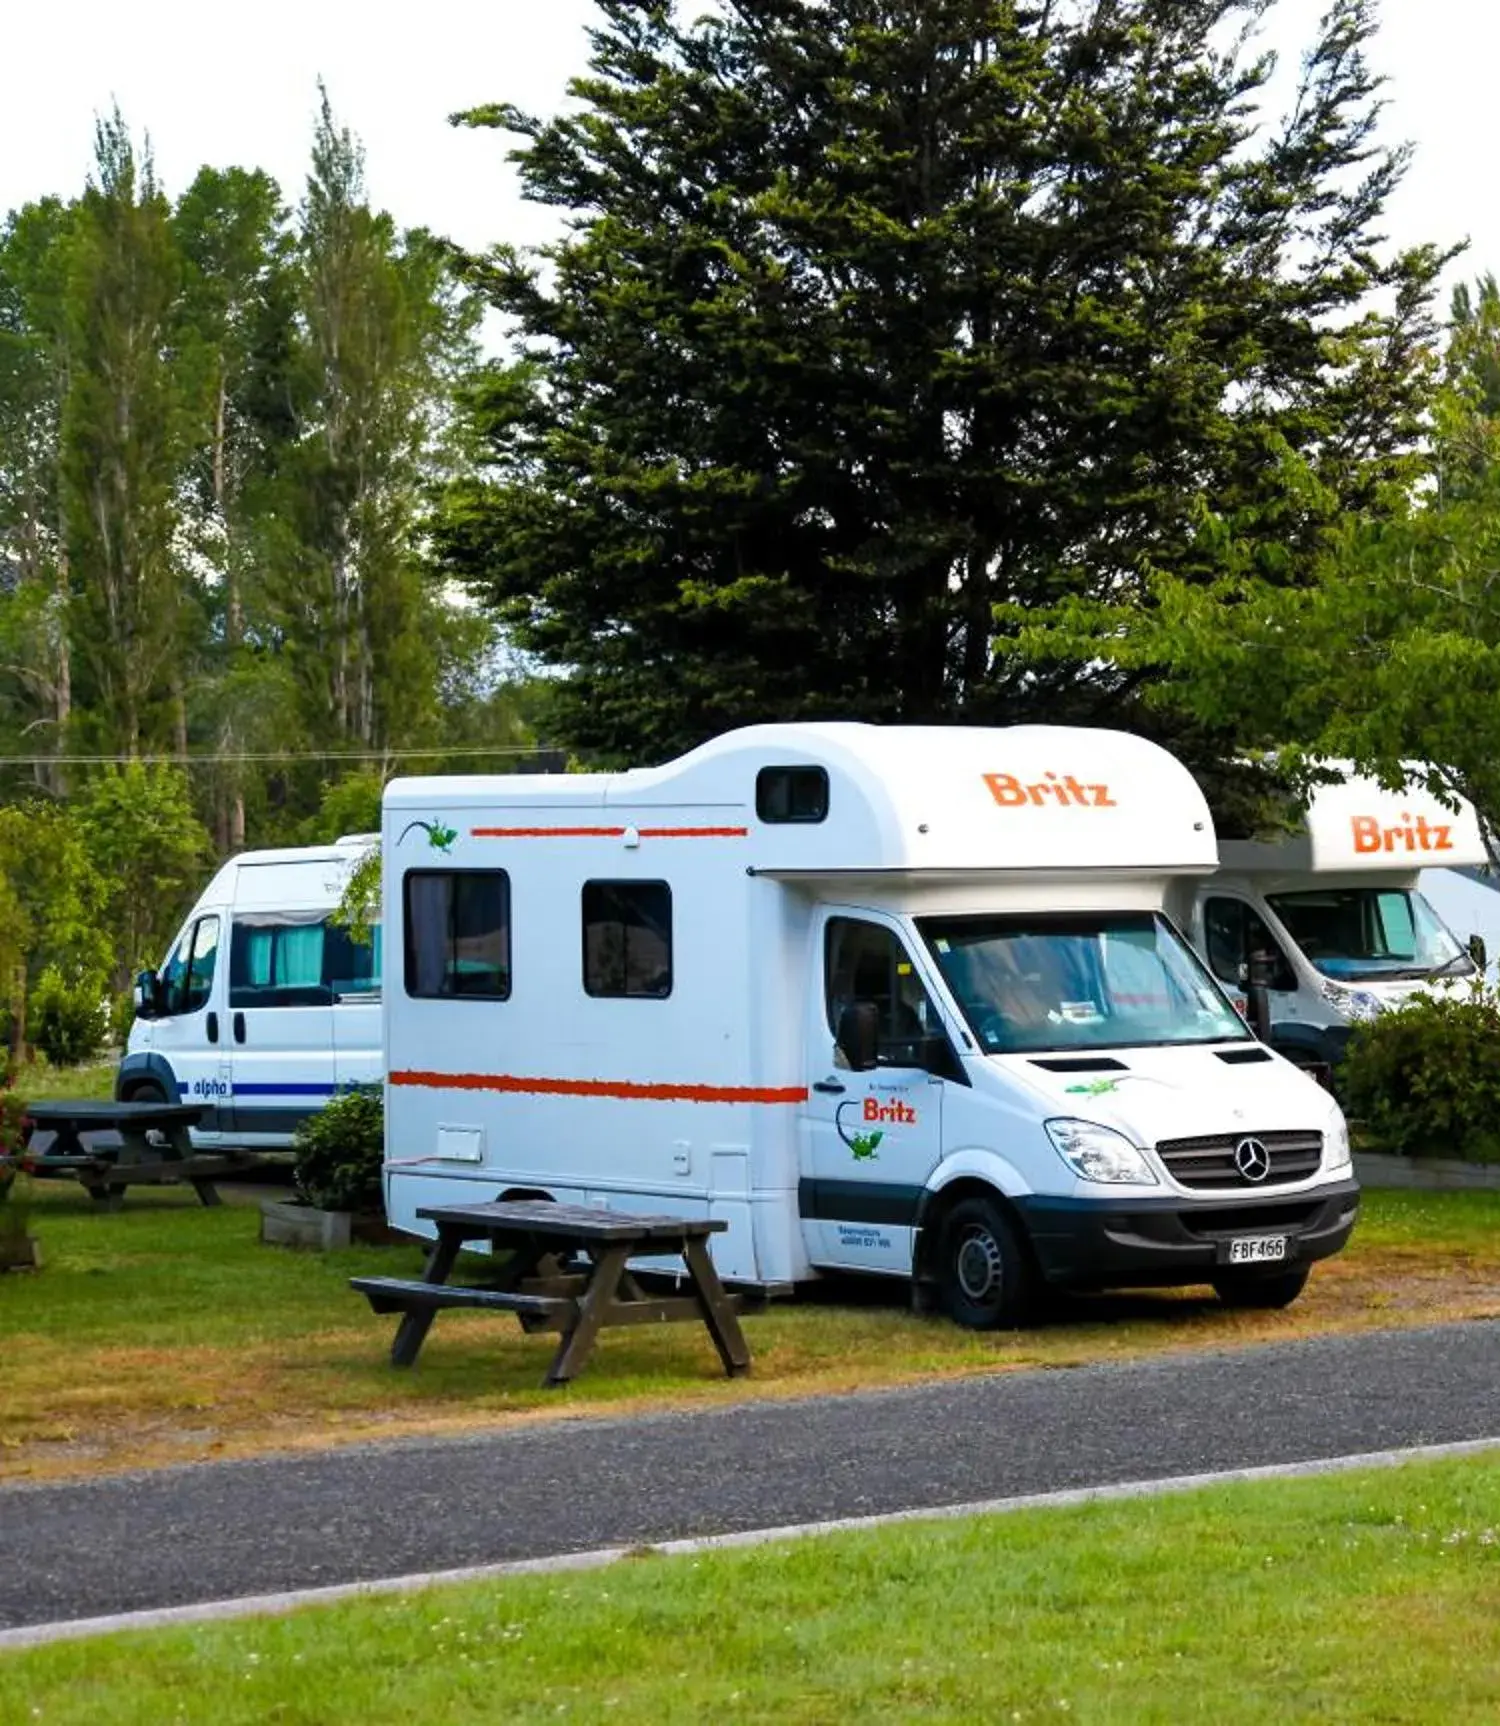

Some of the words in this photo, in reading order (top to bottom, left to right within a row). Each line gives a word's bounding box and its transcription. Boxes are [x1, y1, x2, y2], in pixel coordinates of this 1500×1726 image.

[979, 771, 1118, 807] Britz
[1350, 811, 1454, 853] Britz
[193, 1077, 227, 1100] alpha
[863, 1097, 917, 1124] Britz
[1232, 1239, 1284, 1259] FBF466
